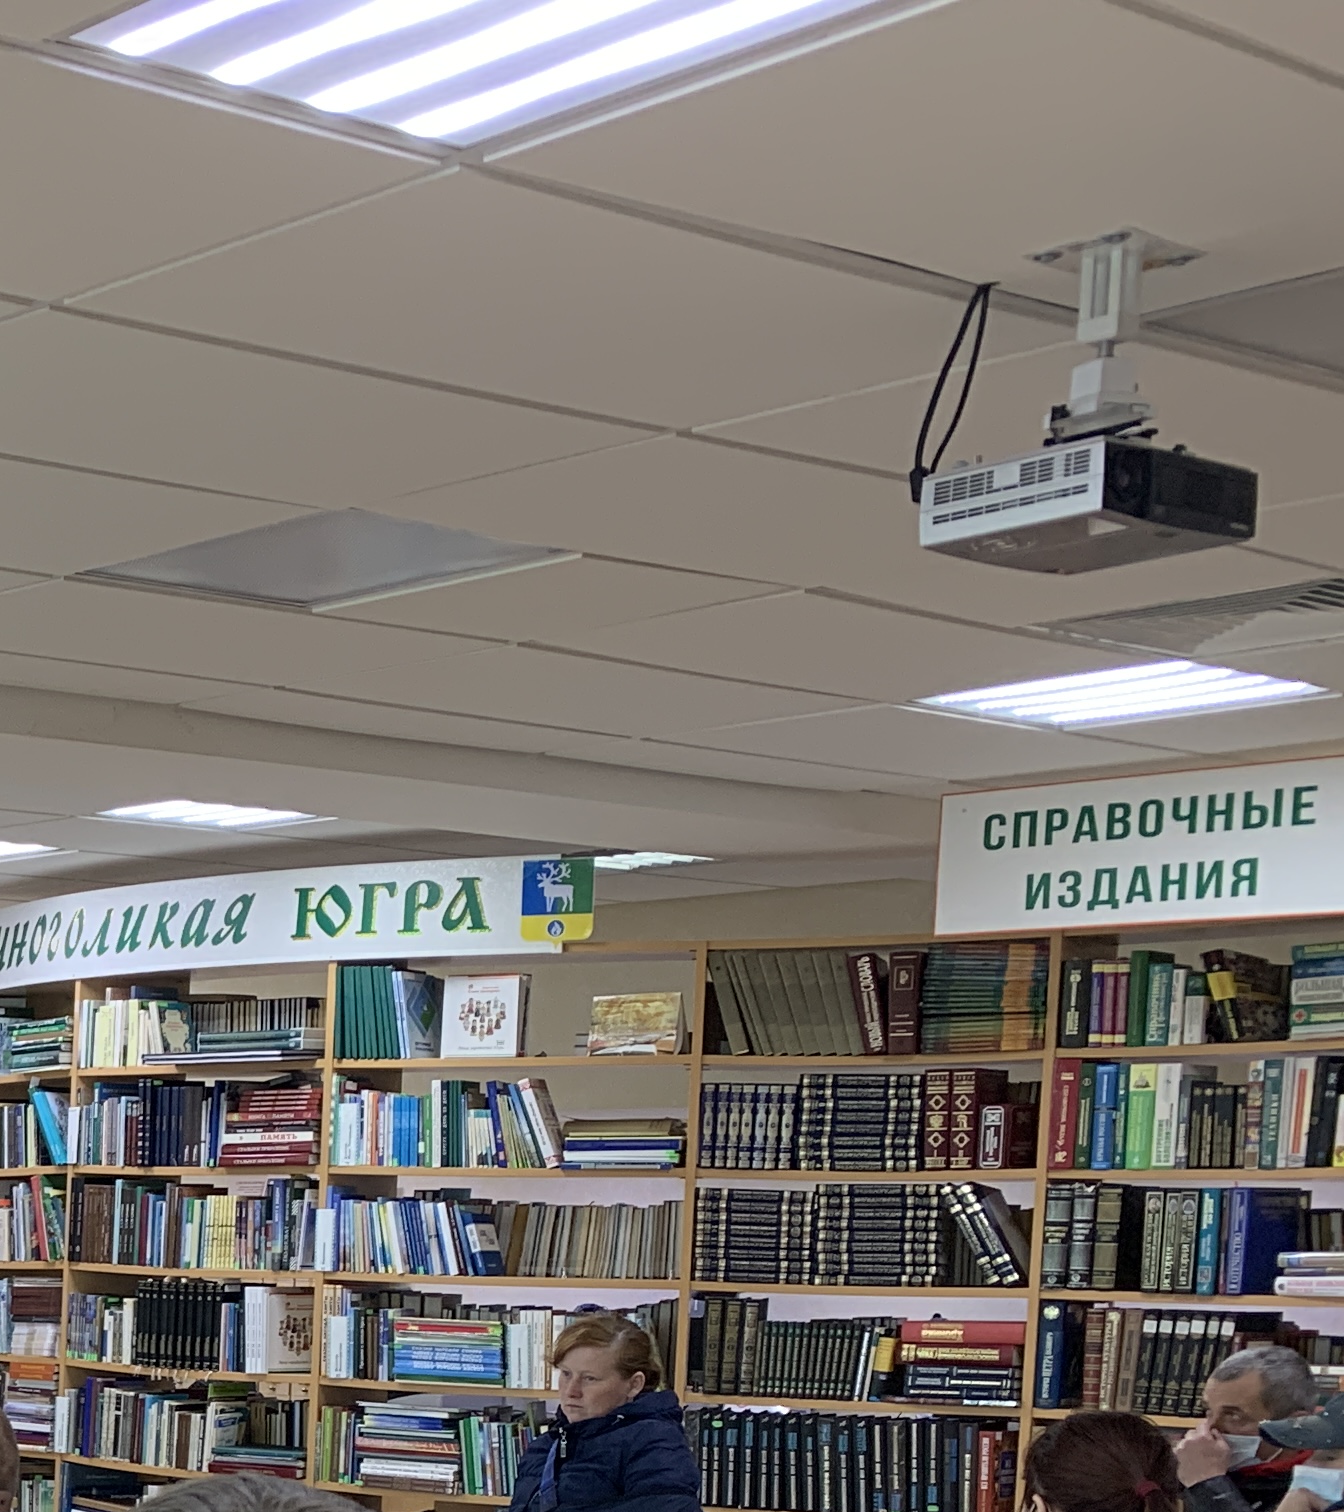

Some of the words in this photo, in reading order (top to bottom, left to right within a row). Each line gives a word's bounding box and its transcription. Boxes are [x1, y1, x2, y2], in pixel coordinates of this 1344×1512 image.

[982, 785, 1318, 851] СПРАВОЧНЫЕ
[1024, 857, 1260, 911] ИЗДАНИЯ
[290, 877, 492, 941] ЮГРА
[857, 956, 874, 991] СЛОВАРЬ
[1268, 1093, 1279, 1141] ТЕХНИКИ
[1162, 1246, 1174, 1288] ИСТОРИЯ
[1178, 1243, 1191, 1286] ИСТОРИЯ
[1102, 1322, 1112, 1361] КУЛЬТУРЫ
[1042, 1355, 1054, 1377] ПЕТРА
